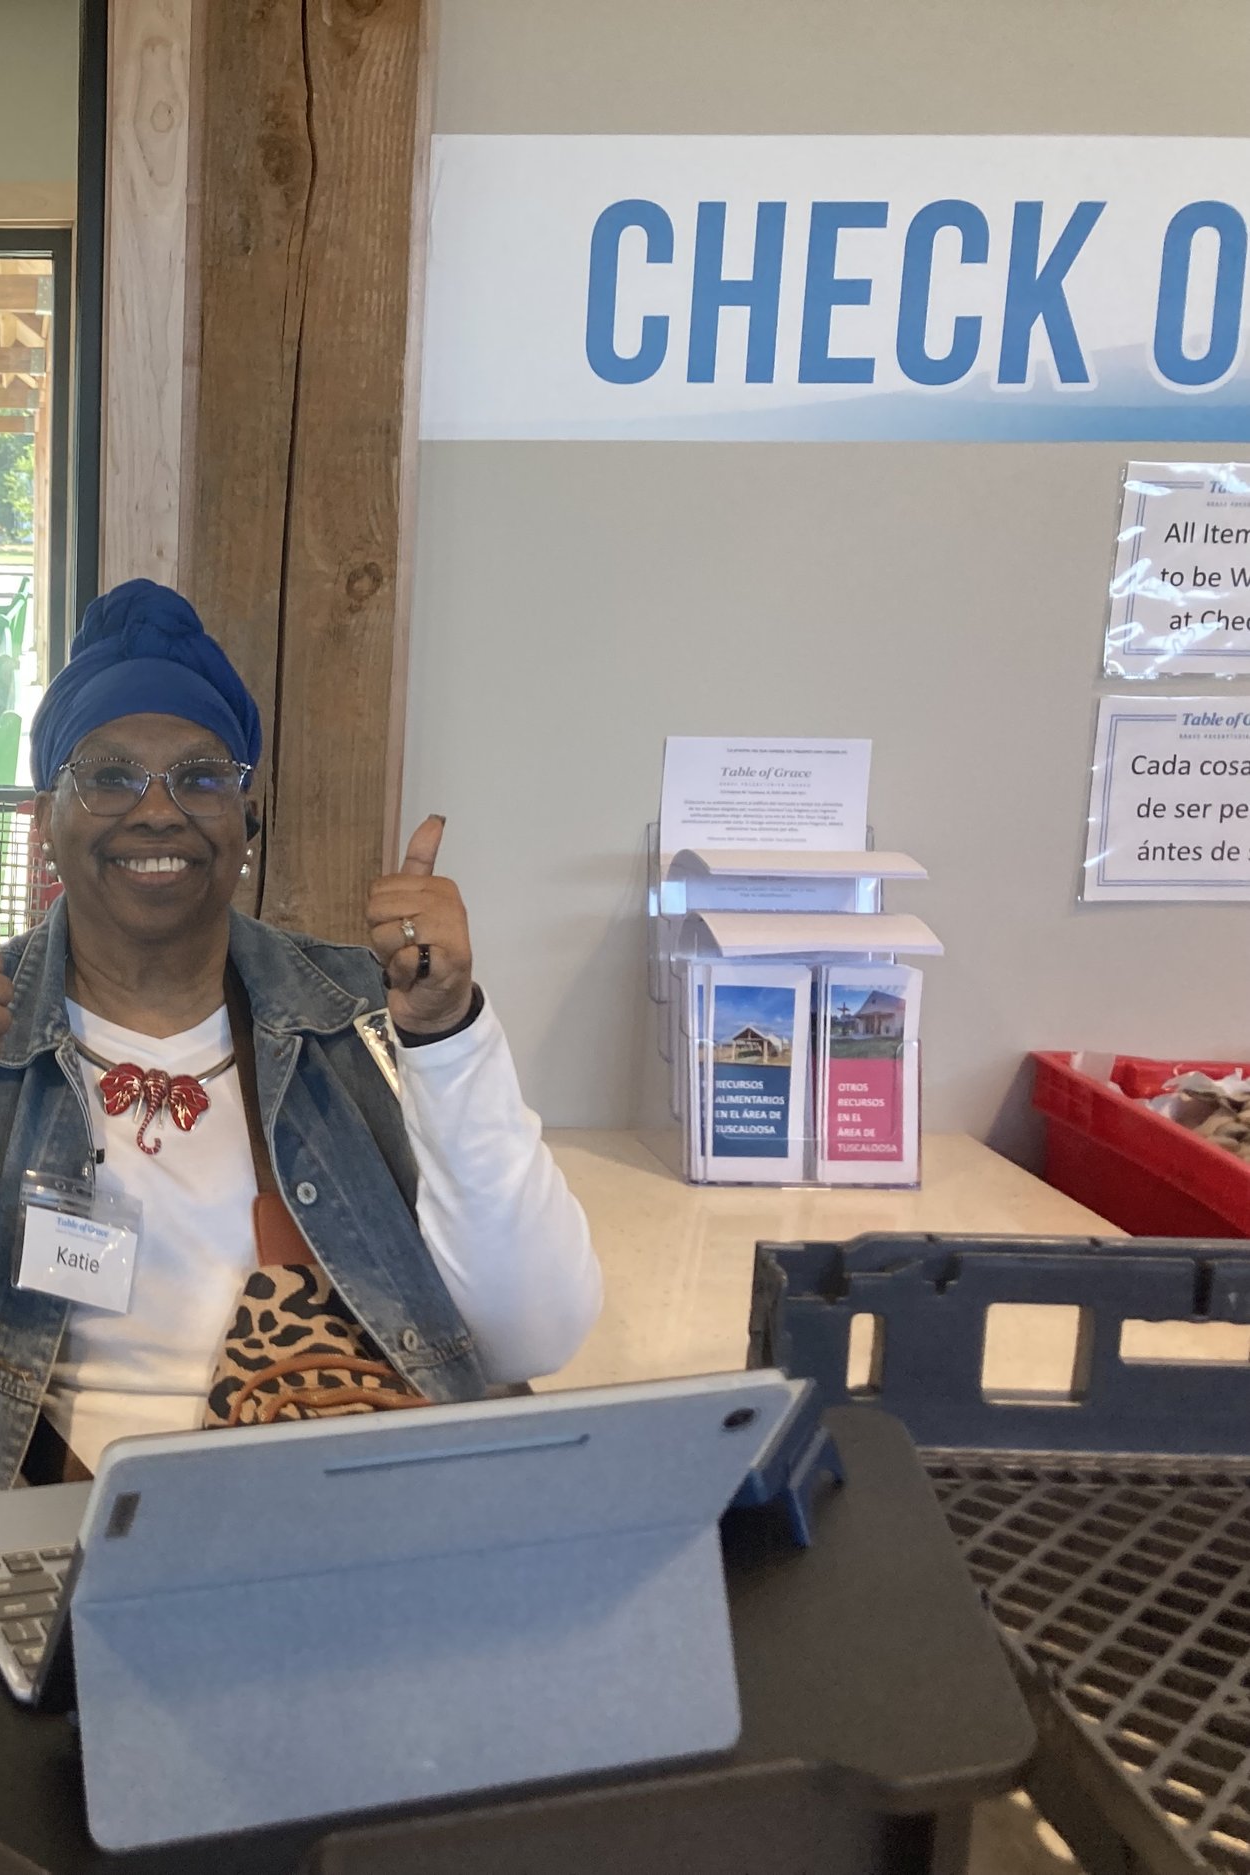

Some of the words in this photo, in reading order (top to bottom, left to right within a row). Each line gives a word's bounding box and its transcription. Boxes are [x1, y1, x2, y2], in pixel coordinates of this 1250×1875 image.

[585, 198, 1107, 385] CHECK
[1153, 200, 1249, 386] O
[1164, 520, 1196, 544] All
[1161, 567, 1185, 588] to
[1192, 565, 1222, 588] be
[1169, 611, 1193, 630] at
[1182, 711, 1224, 727] Table
[1225, 711, 1243, 729] of
[1131, 754, 1191, 776] Cada
[1200, 759, 1250, 776] cosa
[720, 767, 757, 778] Table
[759, 767, 775, 780] of
[774, 768, 812, 779] Grace
[1136, 797, 1167, 819] de
[1174, 802, 1213, 819] ser
[1219, 802, 1249, 824] pe
[1137, 839, 1203, 862] ántes
[1211, 840, 1241, 862] de
[715, 1080, 764, 1090] RECURSOS
[837, 1083, 869, 1092] OTROS
[715, 1095, 785, 1105] ALIMENTARIOS
[837, 1098, 885, 1107] RECURSOS
[715, 1111, 729, 1119] EN
[730, 1111, 740, 1119] EL
[742, 1108, 767, 1120] ÁREA
[769, 1111, 782, 1120] DE
[837, 1113, 850, 1122] EN
[852, 1113, 862, 1122] EL
[715, 1124, 776, 1134] TUSCALOOSA
[837, 1127, 863, 1137] ÁREA
[864, 1128, 876, 1137] DE
[837, 1143, 898, 1153] TUSCALOOSA
[56, 1245, 100, 1274] Katie
